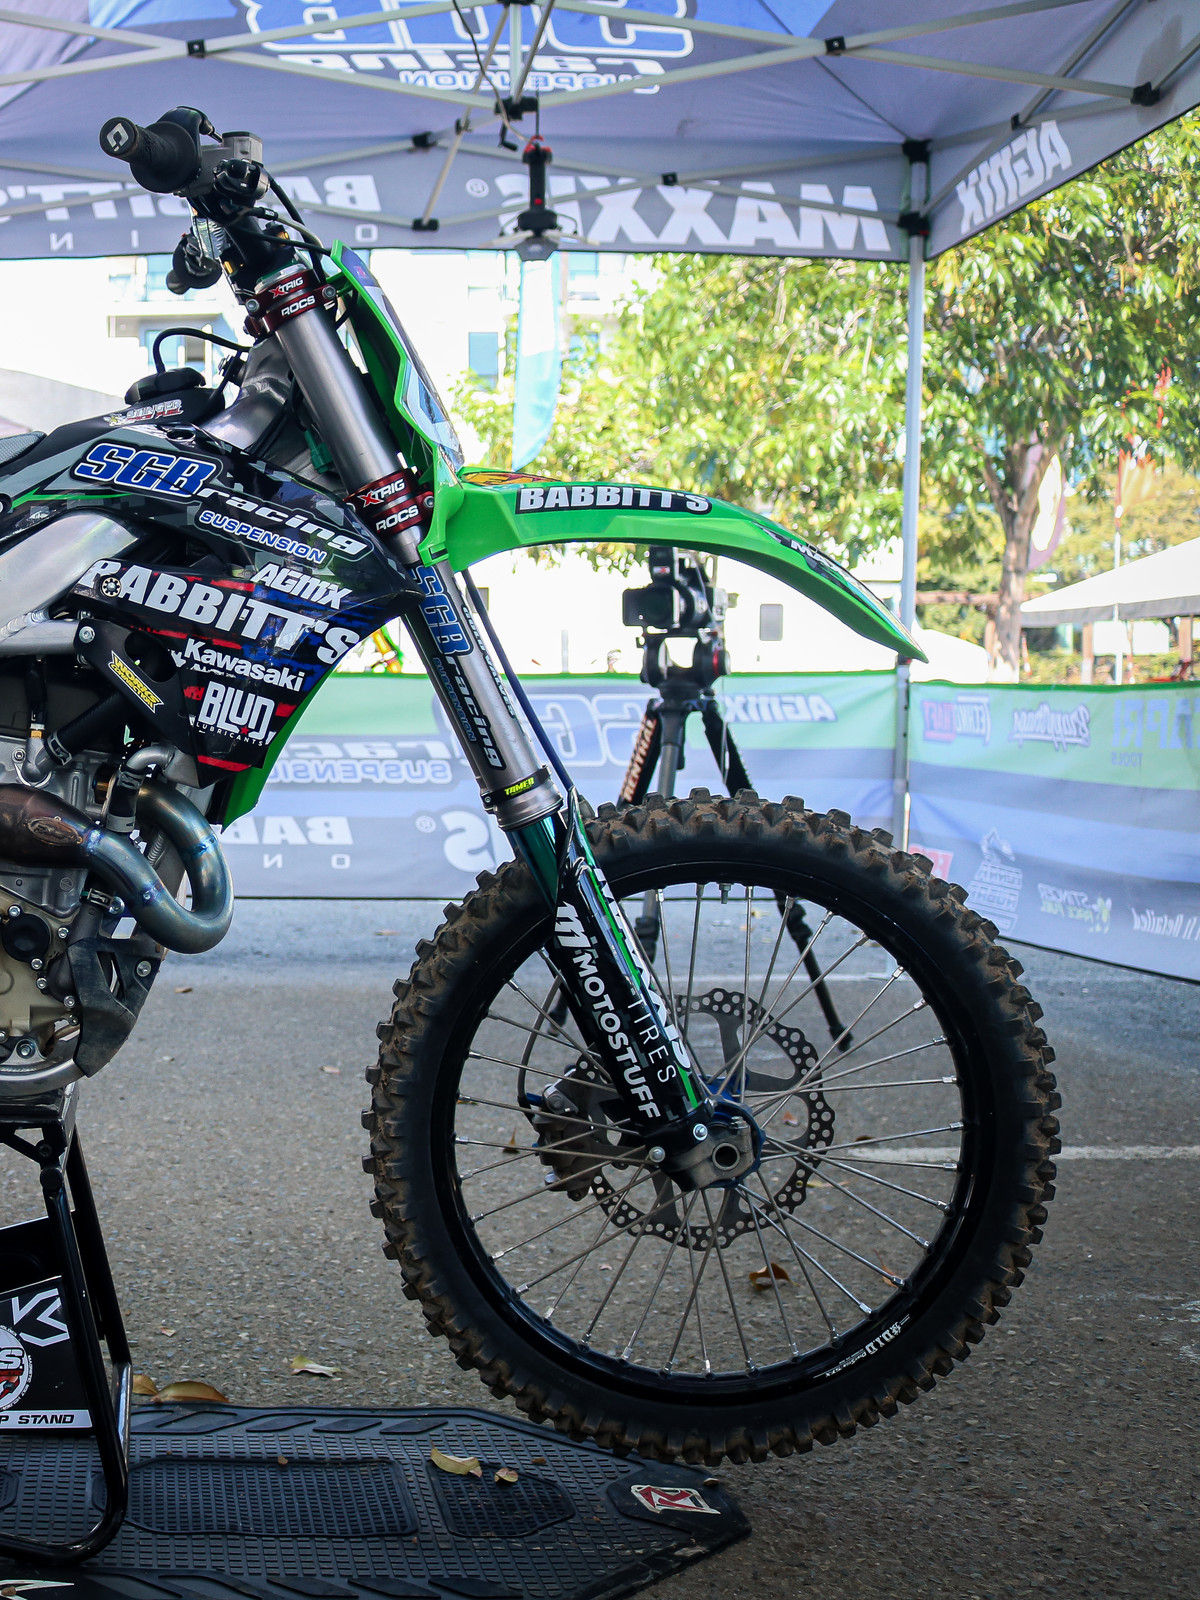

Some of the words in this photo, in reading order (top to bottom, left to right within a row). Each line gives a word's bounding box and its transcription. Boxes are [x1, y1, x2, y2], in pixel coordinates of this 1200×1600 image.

[268, 276, 304, 299] XTRIG
[281, 295, 316, 317] ROCS
[73, 442, 218, 498] SGB
[357, 477, 406, 508] XTRIG
[519, 485, 710, 514] BABBITT'S
[198, 487, 369, 556] racing
[375, 504, 419, 532] ROCS
[199, 510, 327, 565] SUSPENSION
[183, 637, 306, 692] Kawasaki
[195, 720, 266, 748] LUBRICANTS
[572, 952, 661, 1119] MOTOSTUFF
[627, 999, 678, 1084] TIRES
[17, 1413, 75, 1425] STAND
